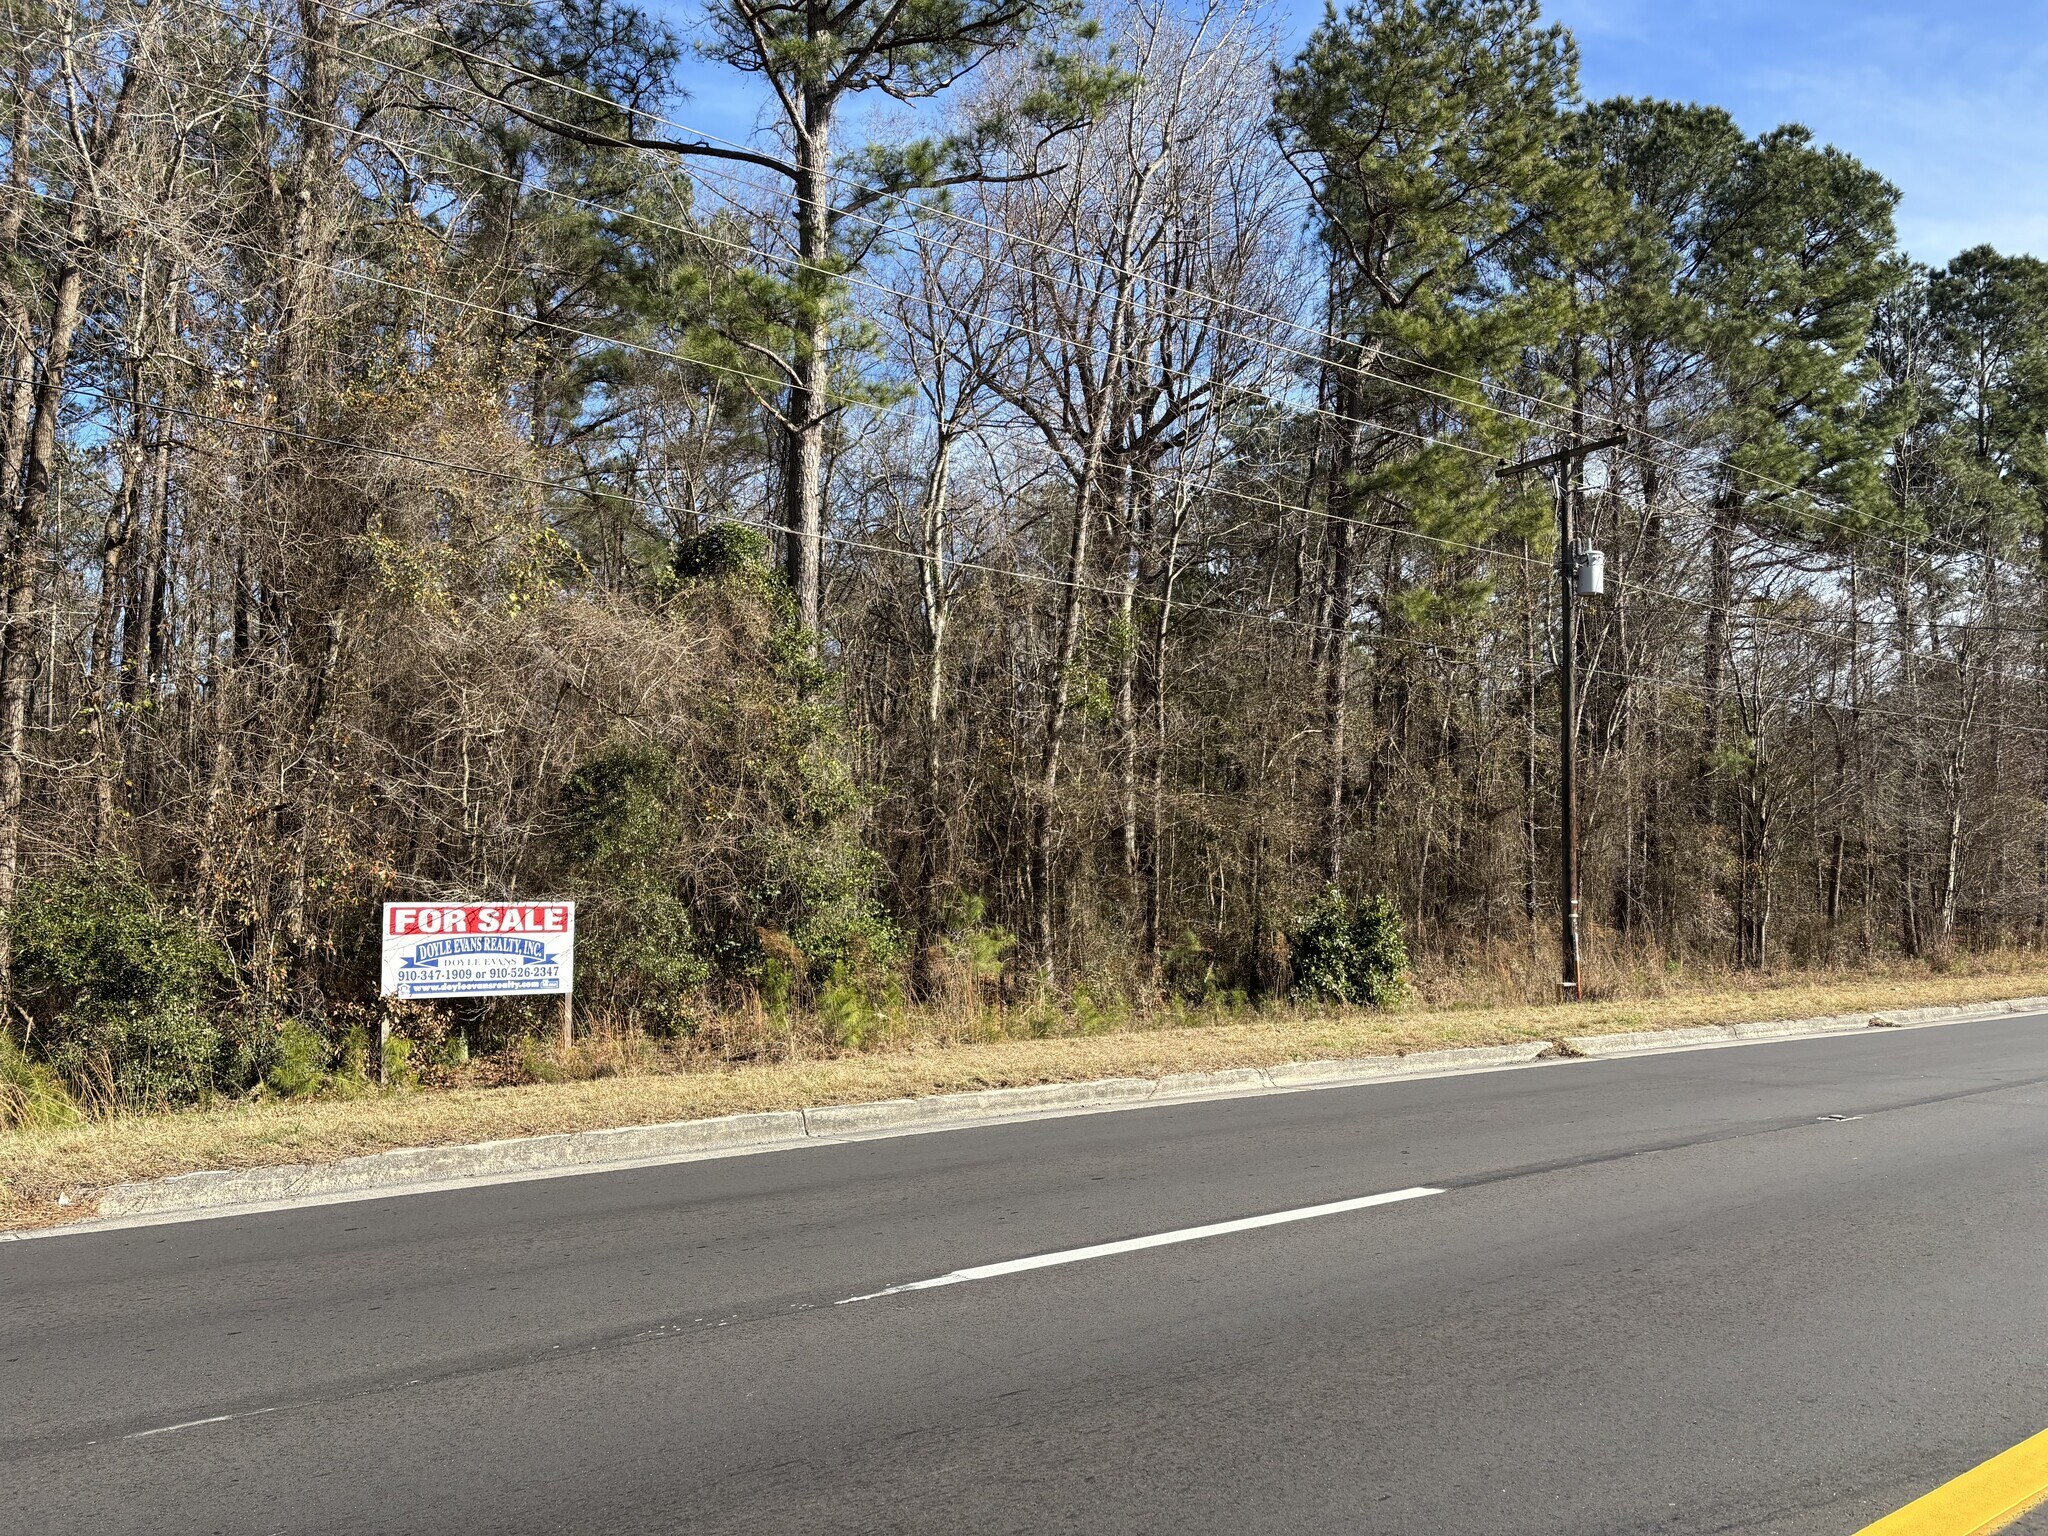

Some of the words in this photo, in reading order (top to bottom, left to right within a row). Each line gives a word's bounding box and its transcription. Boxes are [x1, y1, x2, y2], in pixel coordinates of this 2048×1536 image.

[395, 909, 467, 933] FOR
[478, 908, 563, 932] SALE
[419, 941, 453, 961] DOYLE
[453, 937, 482, 953] EVANS
[484, 937, 522, 955] REALTY,
[523, 941, 542, 958] INC.
[444, 958, 480, 967] DOYLE
[485, 957, 517, 966] EVANS
[398, 969, 472, 981] 910-347-1909
[475, 970, 486, 979] or
[490, 966, 559, 979] 910-526-2347
